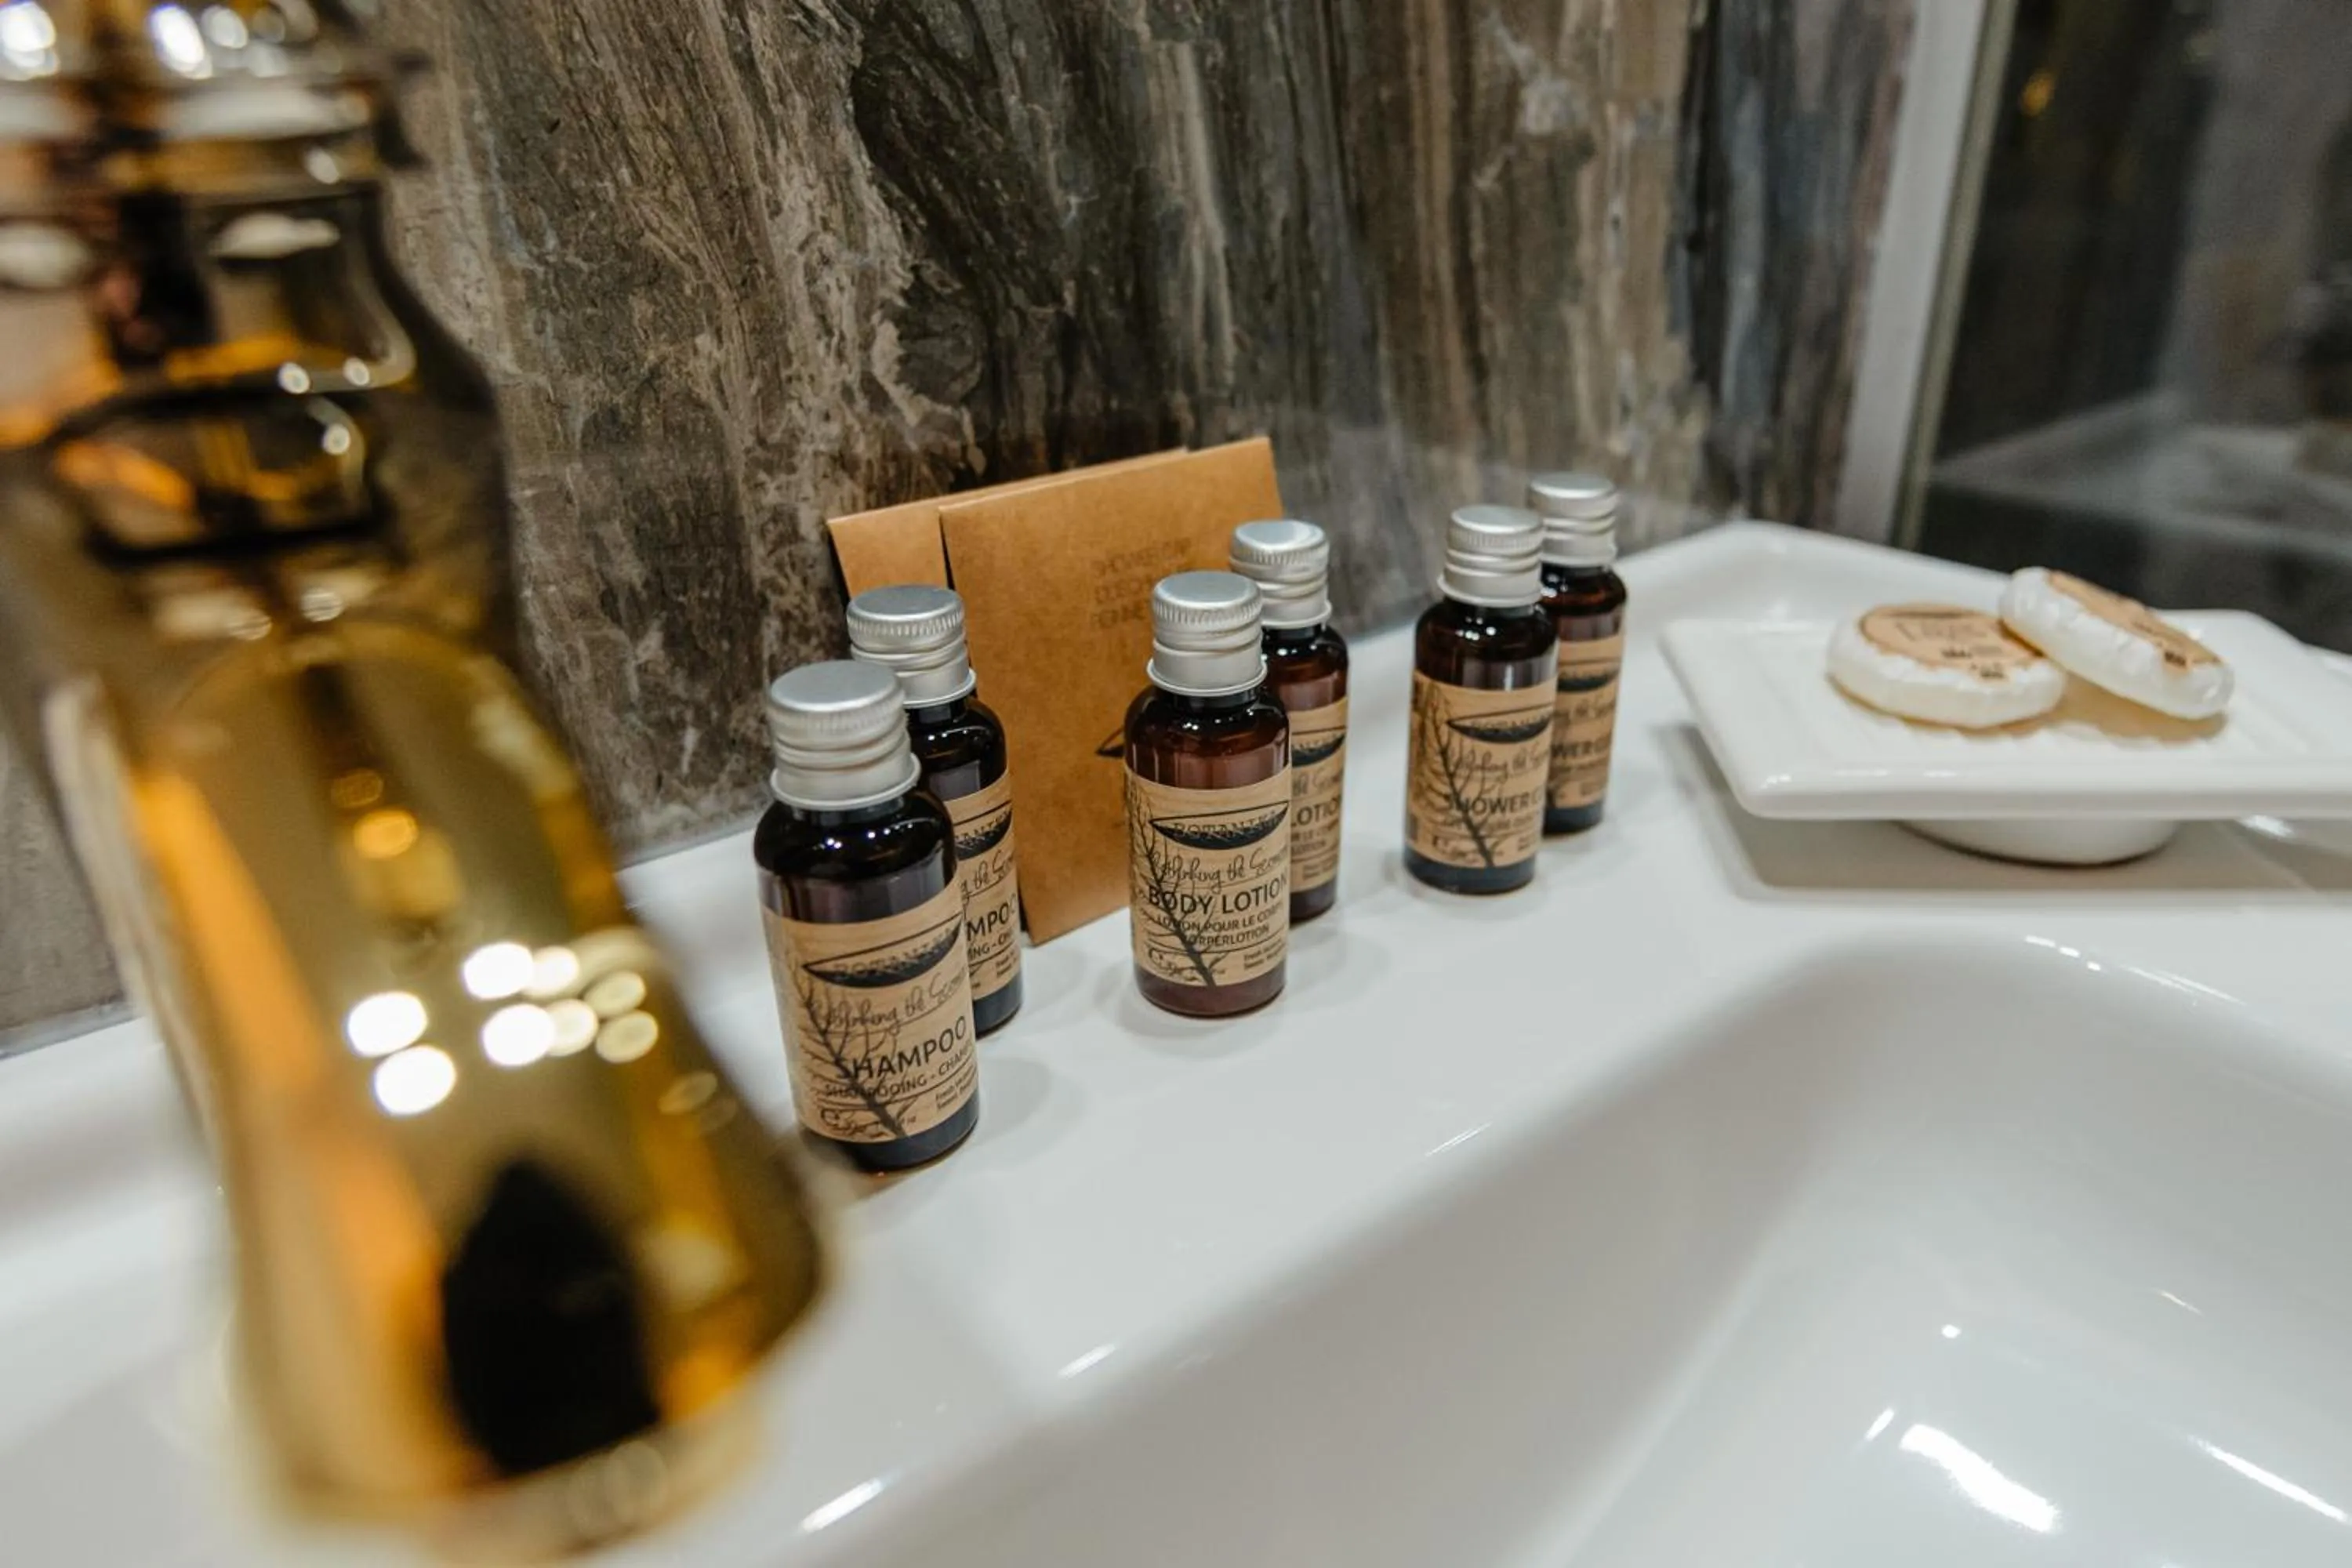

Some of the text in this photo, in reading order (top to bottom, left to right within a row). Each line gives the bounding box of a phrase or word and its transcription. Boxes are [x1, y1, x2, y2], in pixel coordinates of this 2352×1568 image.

[1227, 853, 1245, 878] the
[1149, 873, 1288, 914] BODY LOTION
[1158, 916, 1200, 932] LOON
[1203, 919, 1240, 933] POUR
[1243, 914, 1255, 928] LE
